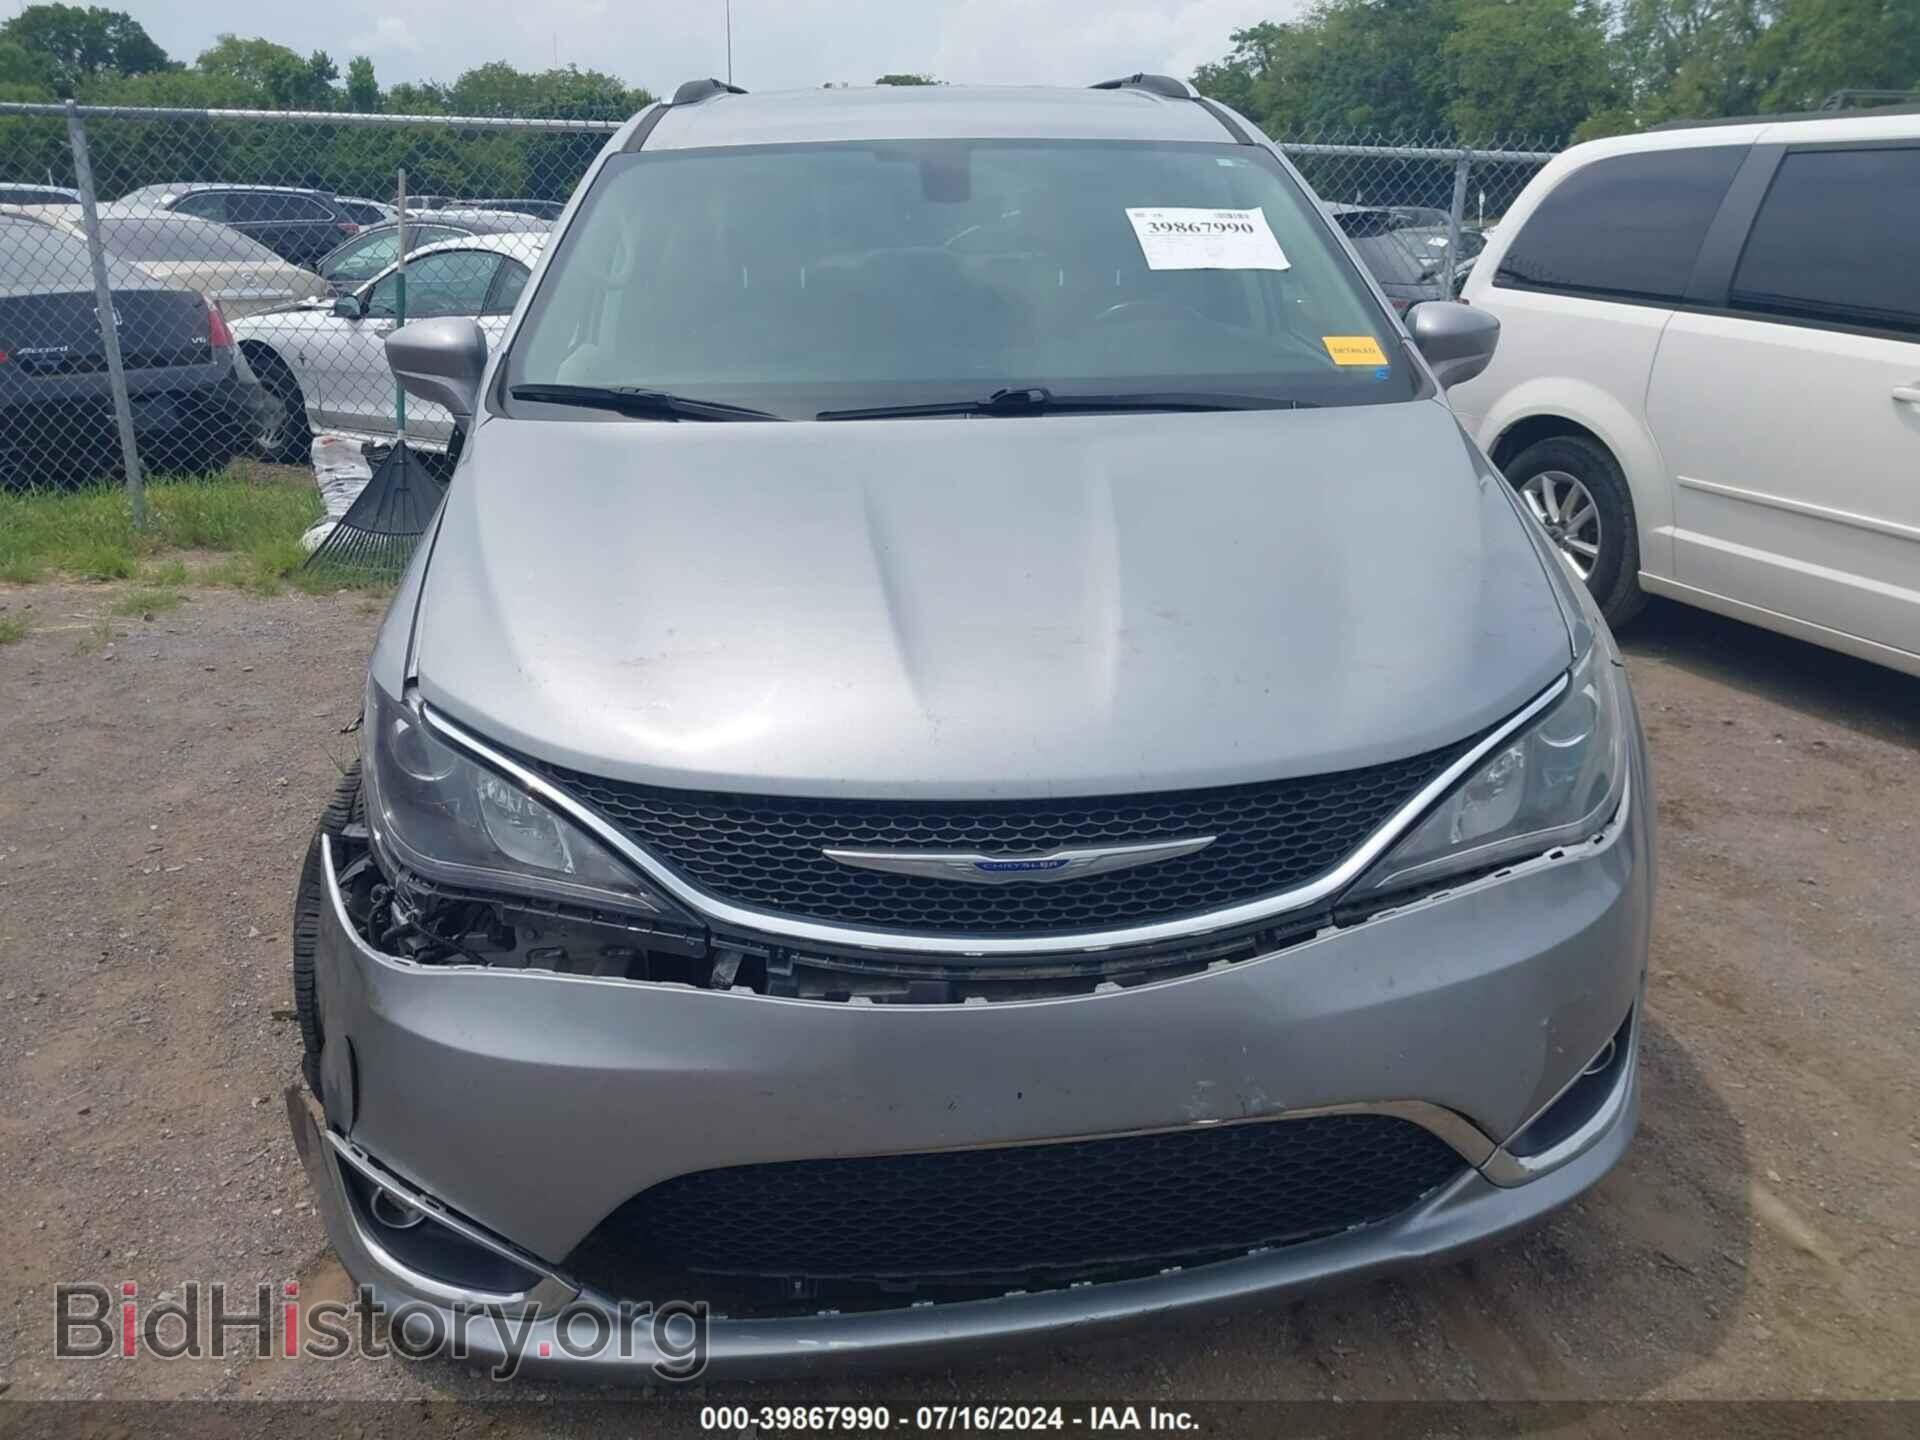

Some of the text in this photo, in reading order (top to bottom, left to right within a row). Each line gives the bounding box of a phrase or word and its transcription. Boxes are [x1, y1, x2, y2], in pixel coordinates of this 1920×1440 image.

[1148, 222, 1254, 233] 39867990
[16, 345, 68, 355] Accord
[983, 862, 1058, 871] CHRYSLER
